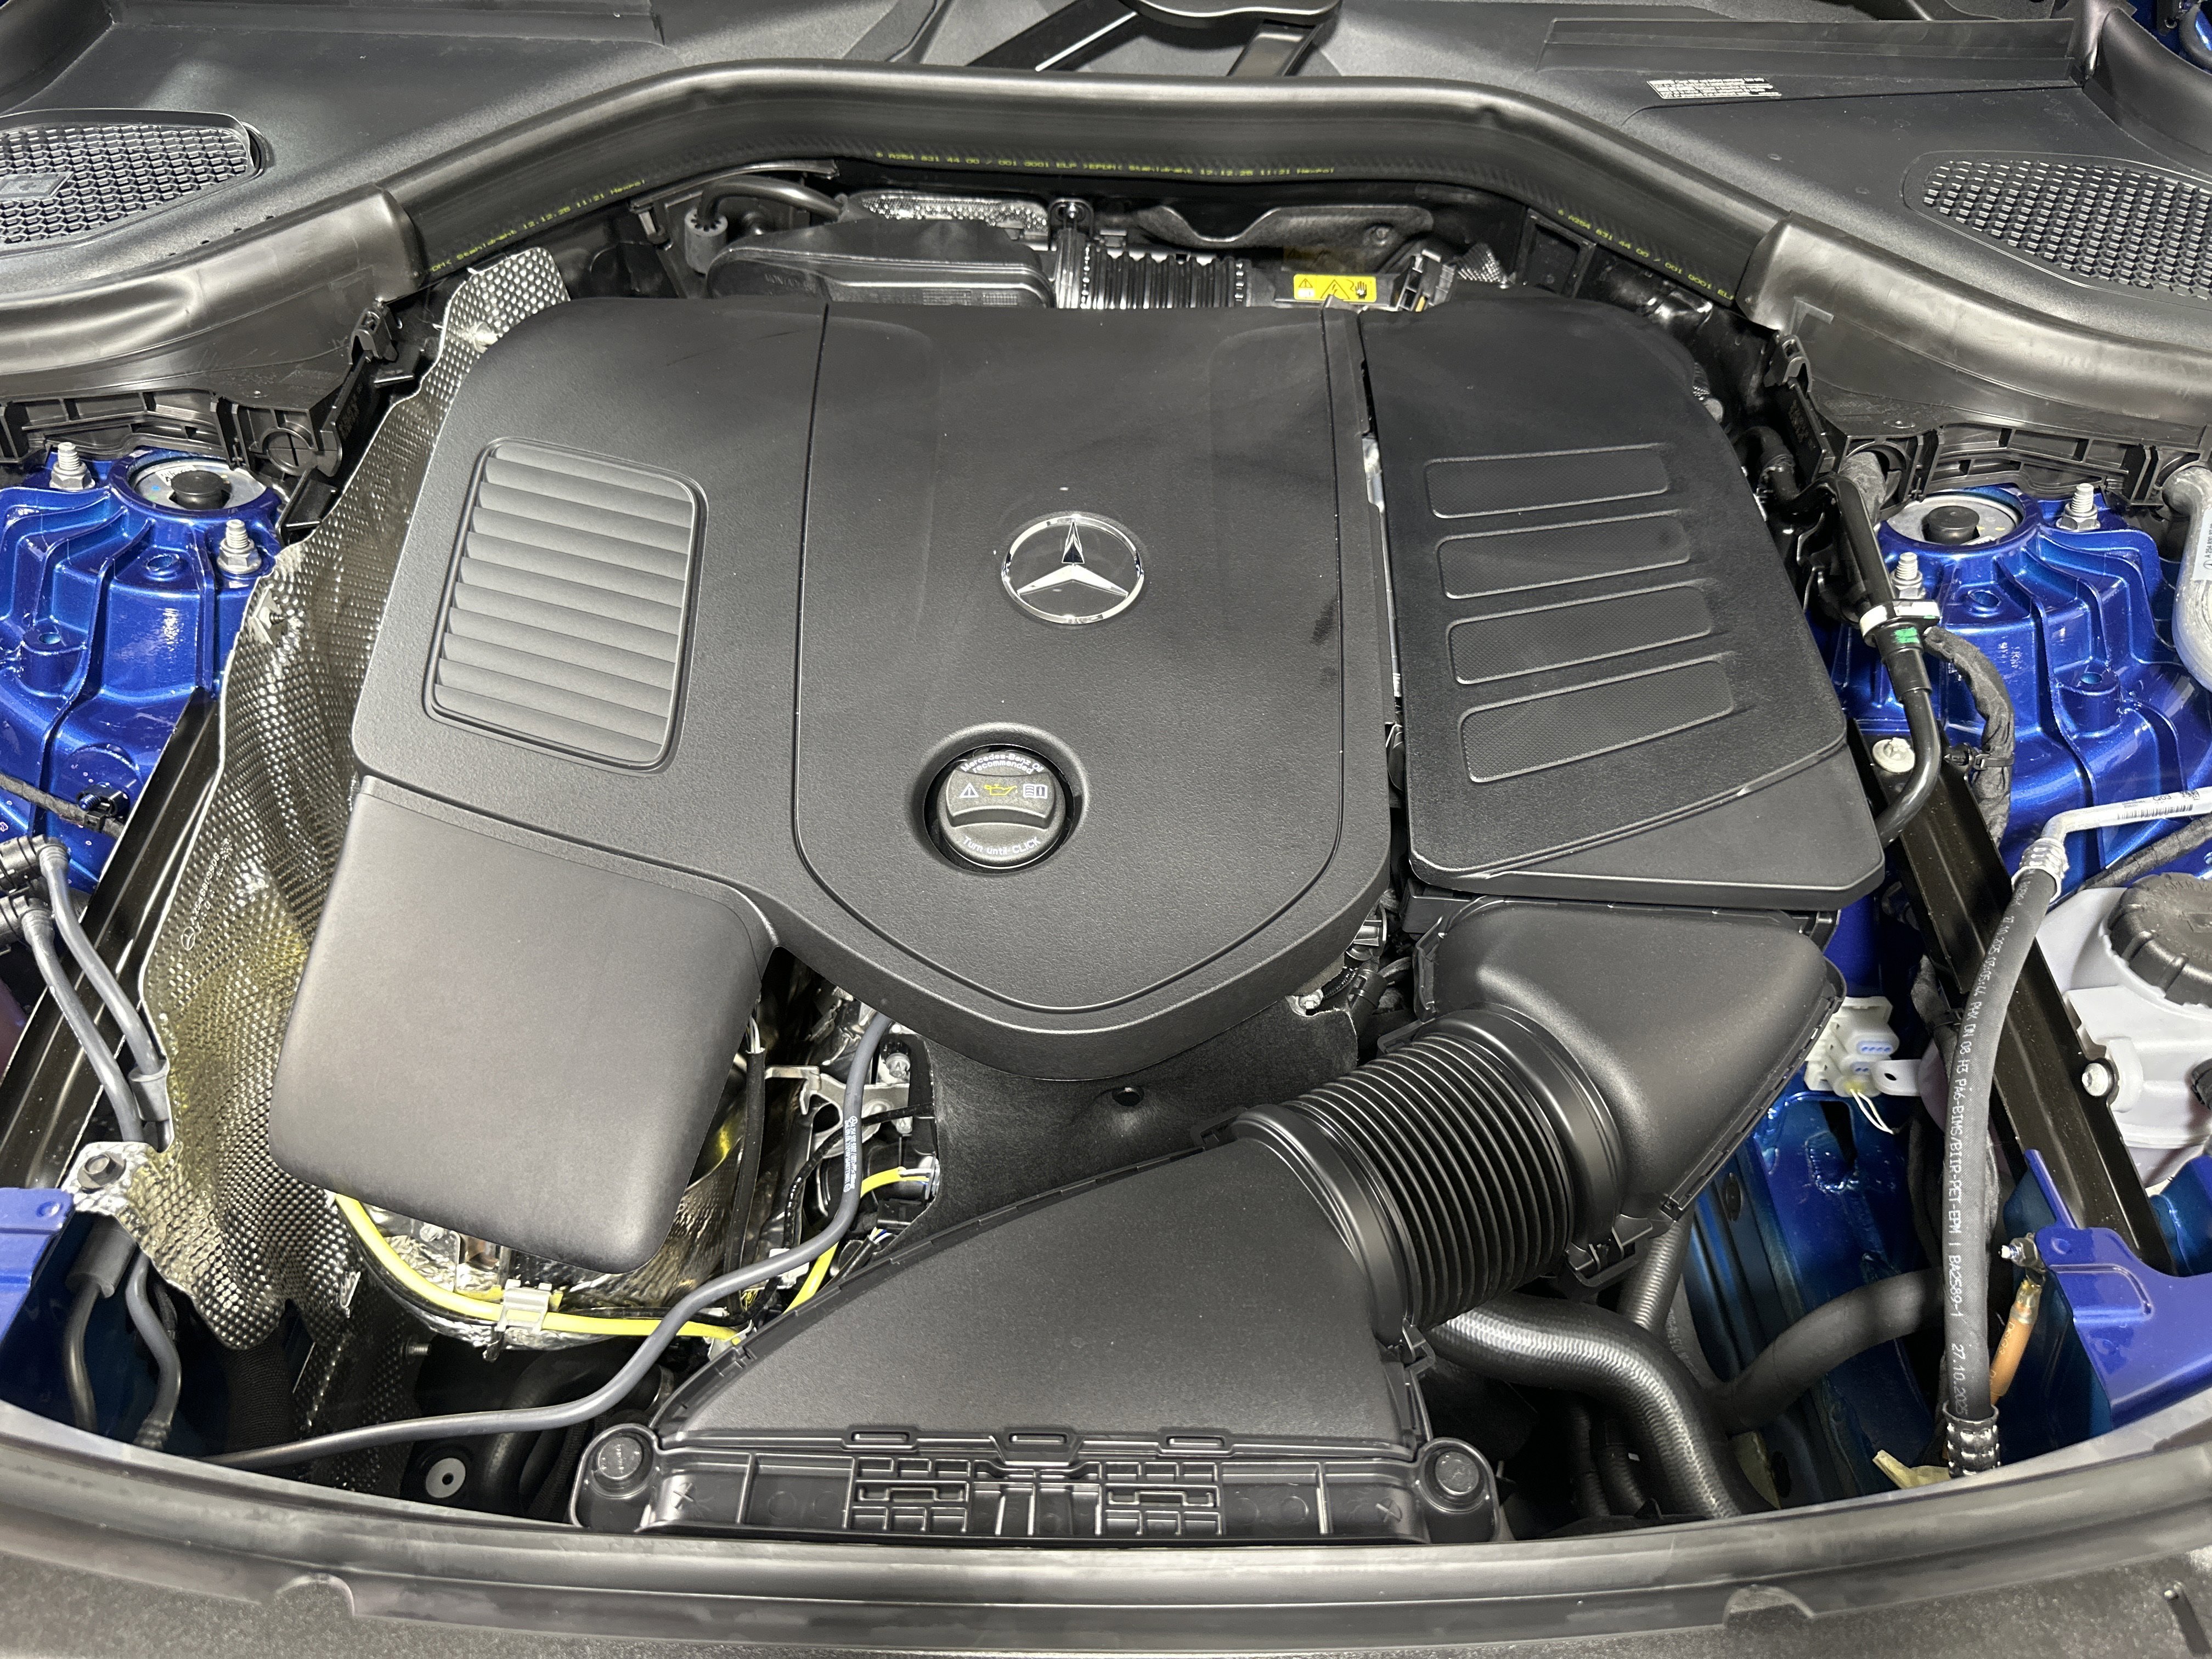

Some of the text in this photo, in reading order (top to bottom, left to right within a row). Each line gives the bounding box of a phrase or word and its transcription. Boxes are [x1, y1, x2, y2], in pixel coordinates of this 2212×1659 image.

[456, 229, 517, 261] Stahldraht
[1618, 240, 1632, 250] 44
[1635, 247, 1650, 258] 00
[960, 753, 1045, 773] Mercedes-Benz Oil
[972, 760, 1035, 775] recommended
[962, 836, 1041, 855] Turn until CLICK
[1959, 1040, 1973, 1056] 08
[1955, 1058, 1971, 1074] H3
[1948, 1254, 1962, 1318] BA2589-1
[1947, 1342, 1967, 1417] 27.10.2025
